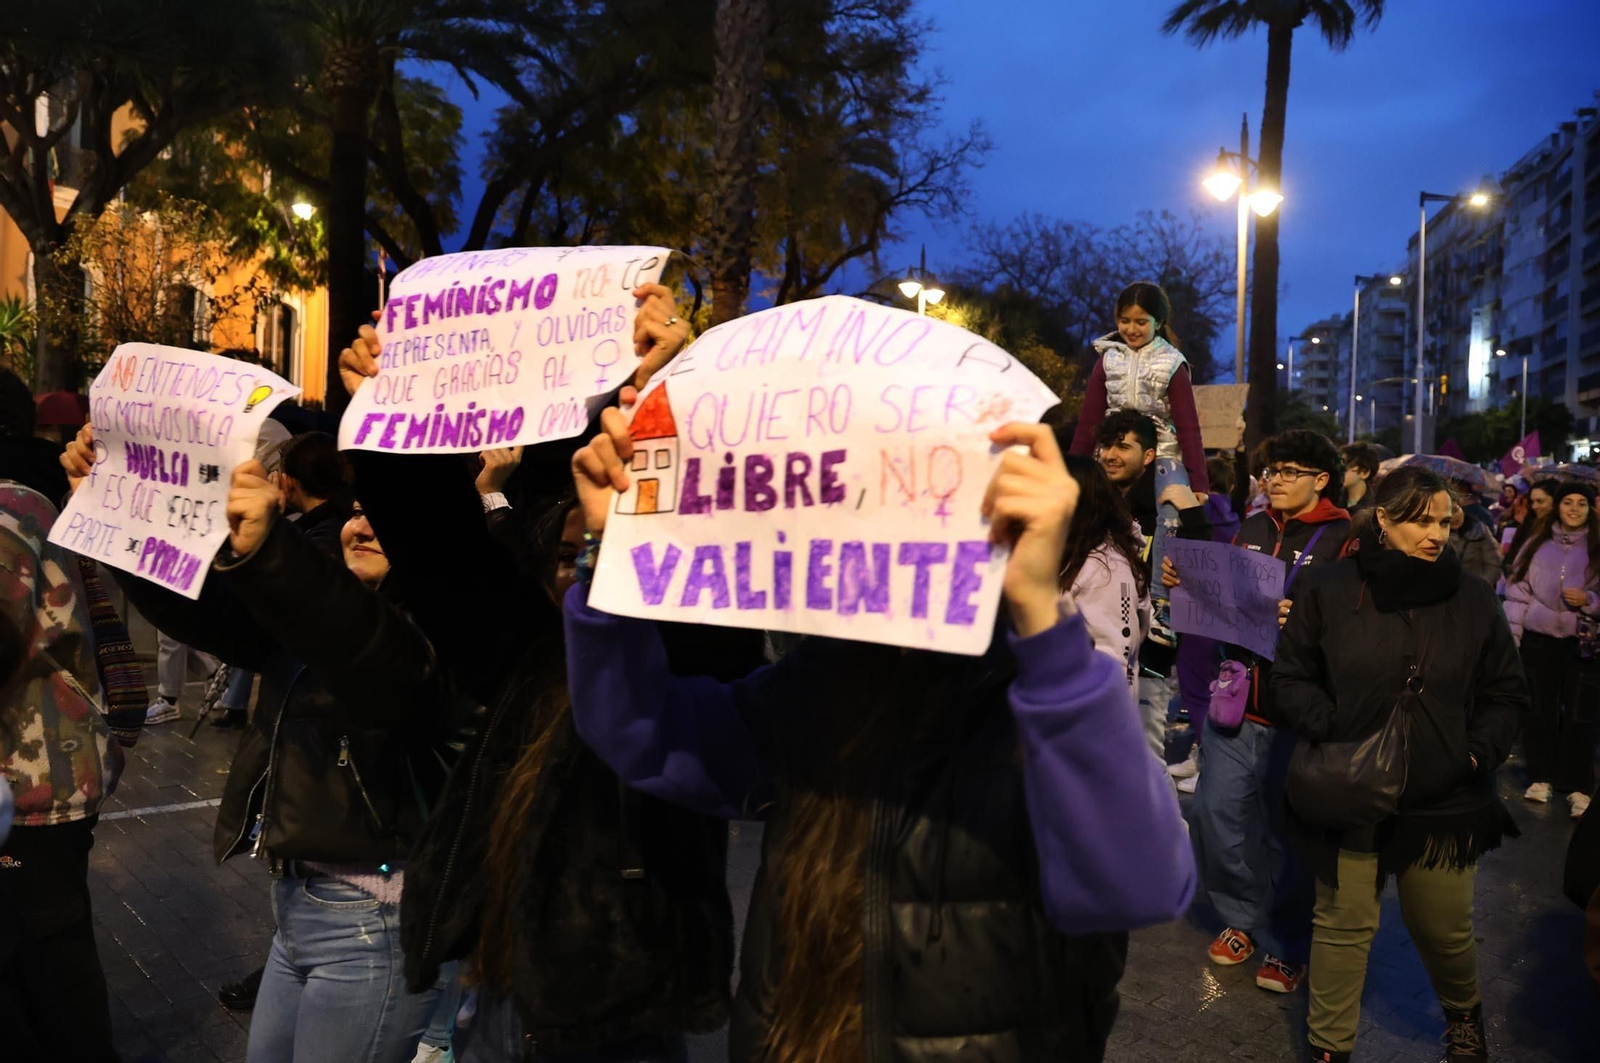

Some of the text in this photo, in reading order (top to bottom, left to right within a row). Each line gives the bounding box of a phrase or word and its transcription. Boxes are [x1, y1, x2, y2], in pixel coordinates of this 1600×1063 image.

[373, 375, 416, 405] QUE
[543, 355, 570, 391] AL
[874, 384, 977, 434] SER
[102, 474, 126, 511] ES
